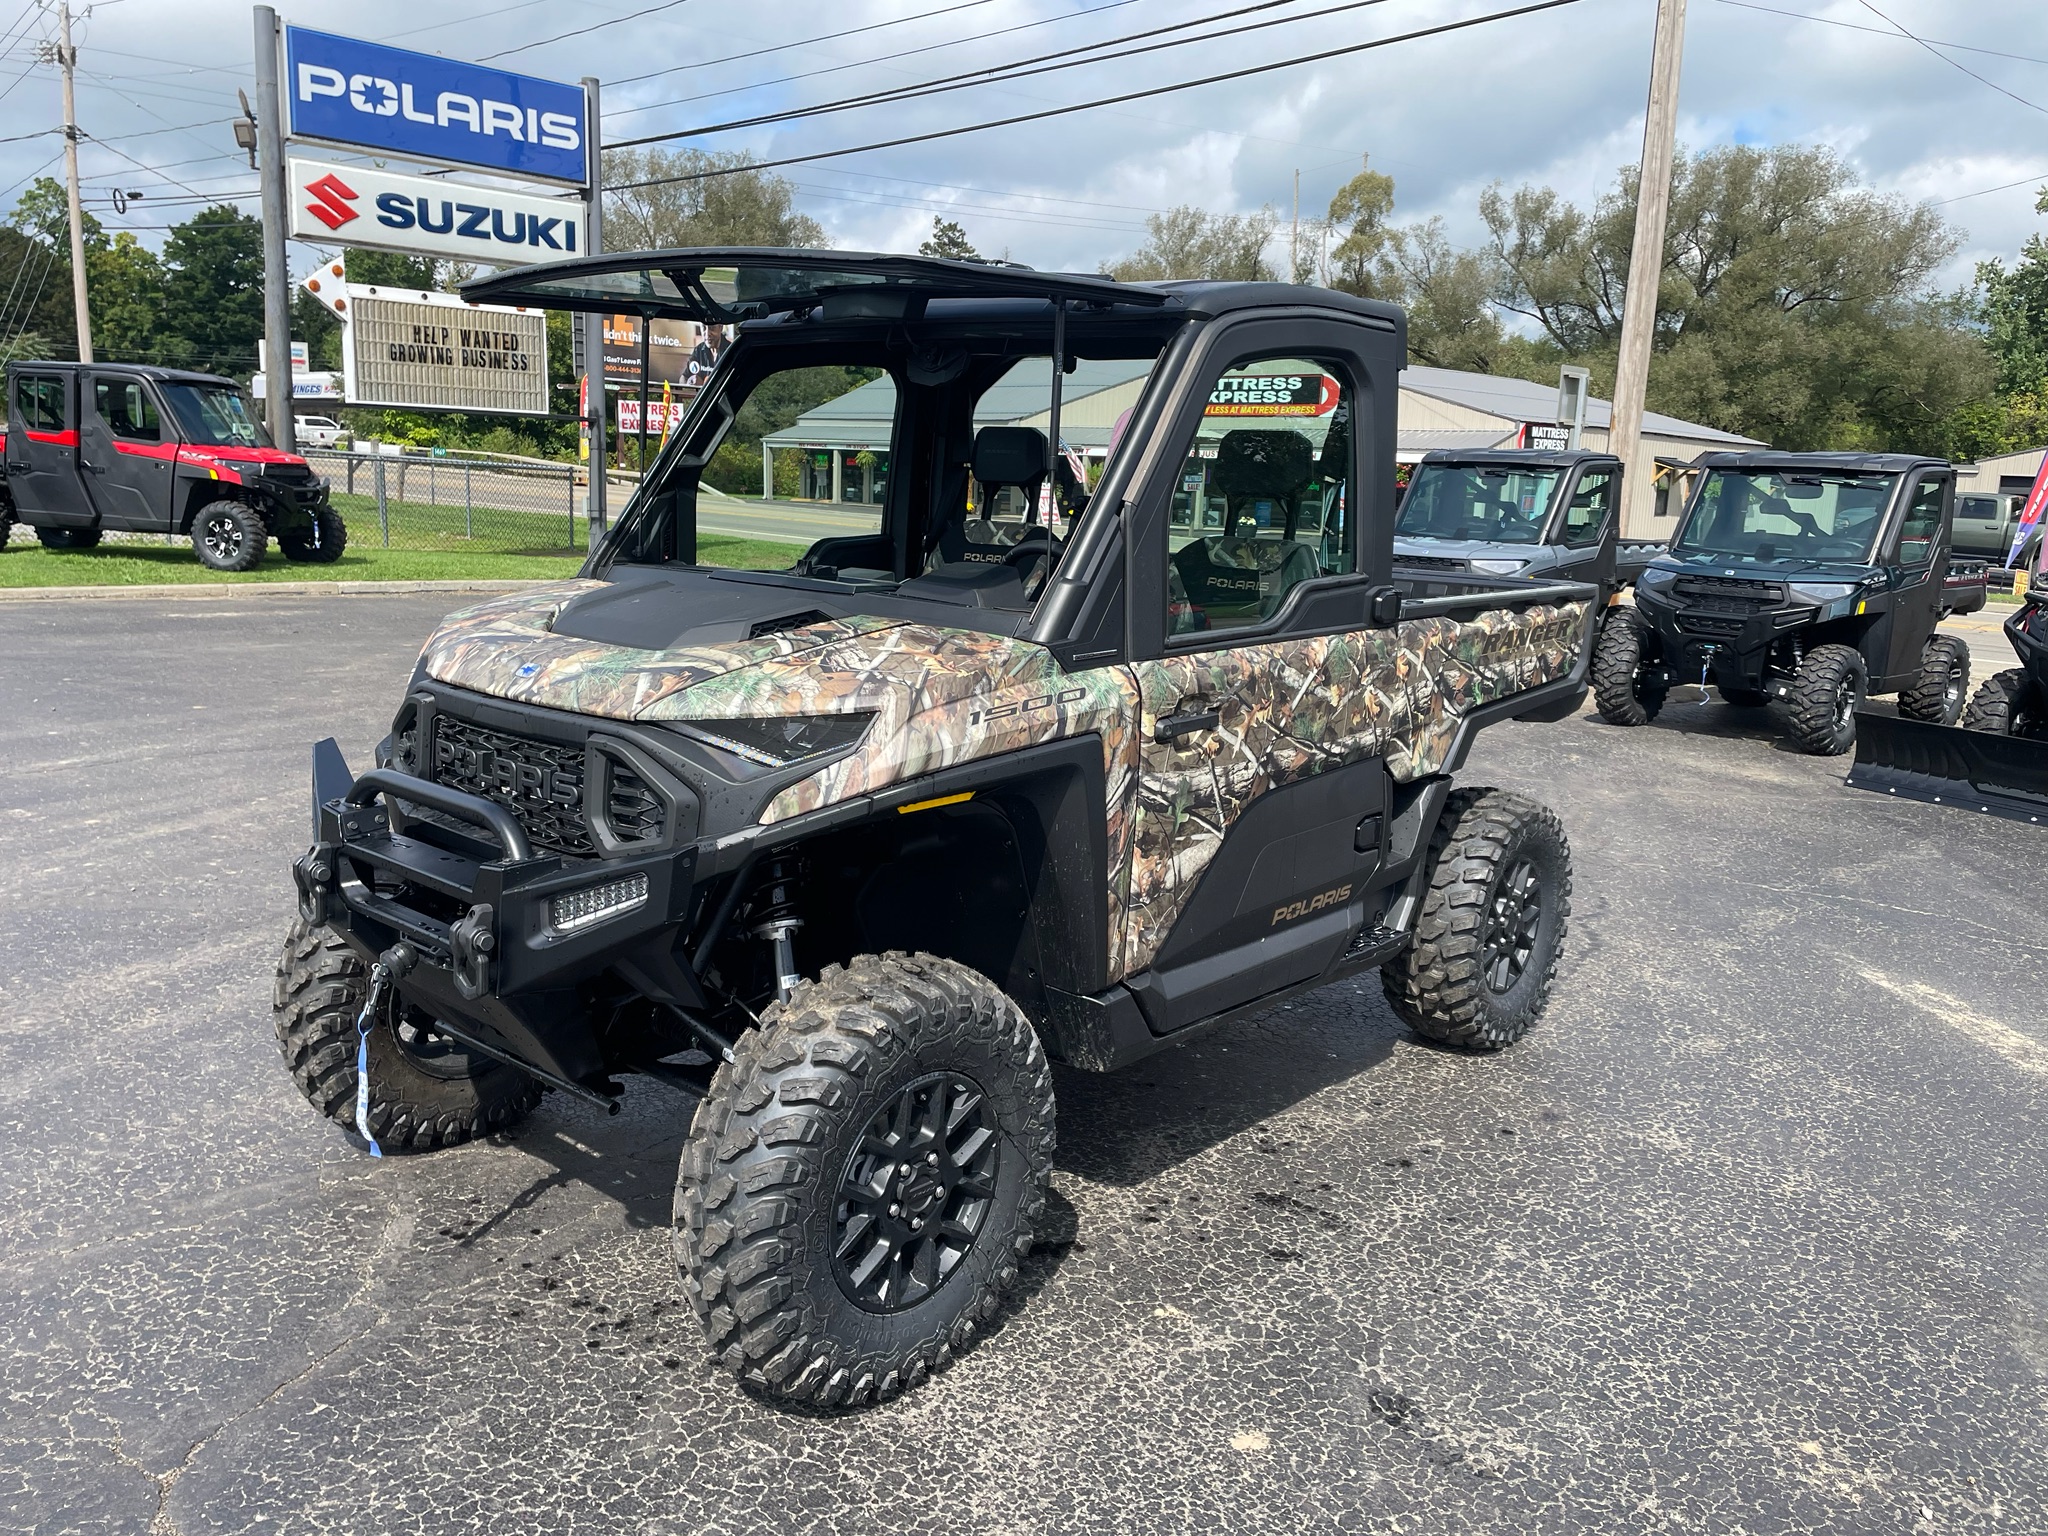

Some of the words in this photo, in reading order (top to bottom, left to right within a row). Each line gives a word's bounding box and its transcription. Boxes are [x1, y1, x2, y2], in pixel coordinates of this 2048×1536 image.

[298, 62, 580, 151] POLARIS
[375, 192, 576, 252] SUZUKI
[413, 325, 449, 345] HELP
[460, 328, 518, 351] WANTED
[603, 328, 627, 341] idn't
[628, 332, 653, 345] thik
[654, 335, 682, 347] twice.
[390, 343, 453, 366] GROWING
[462, 353, 528, 371] BUSINESS
[1214, 377, 1302, 390] TTRESS
[1209, 391, 1292, 403] XPRESS
[1211, 406, 1229, 414] LESS
[1230, 406, 1239, 414] AT
[1240, 406, 1279, 414] MATTRESS
[1280, 406, 1315, 414] EXPRESS
[1532, 426, 1569, 439] MATTRESS
[1533, 439, 1565, 451] EXPRESS
[1207, 576, 1270, 591] POLARIS
[1481, 618, 1571, 656] RANGER
[970, 687, 1087, 726] 1500
[435, 738, 579, 805] POLARIS
[1271, 884, 1352, 926] POLARIS
